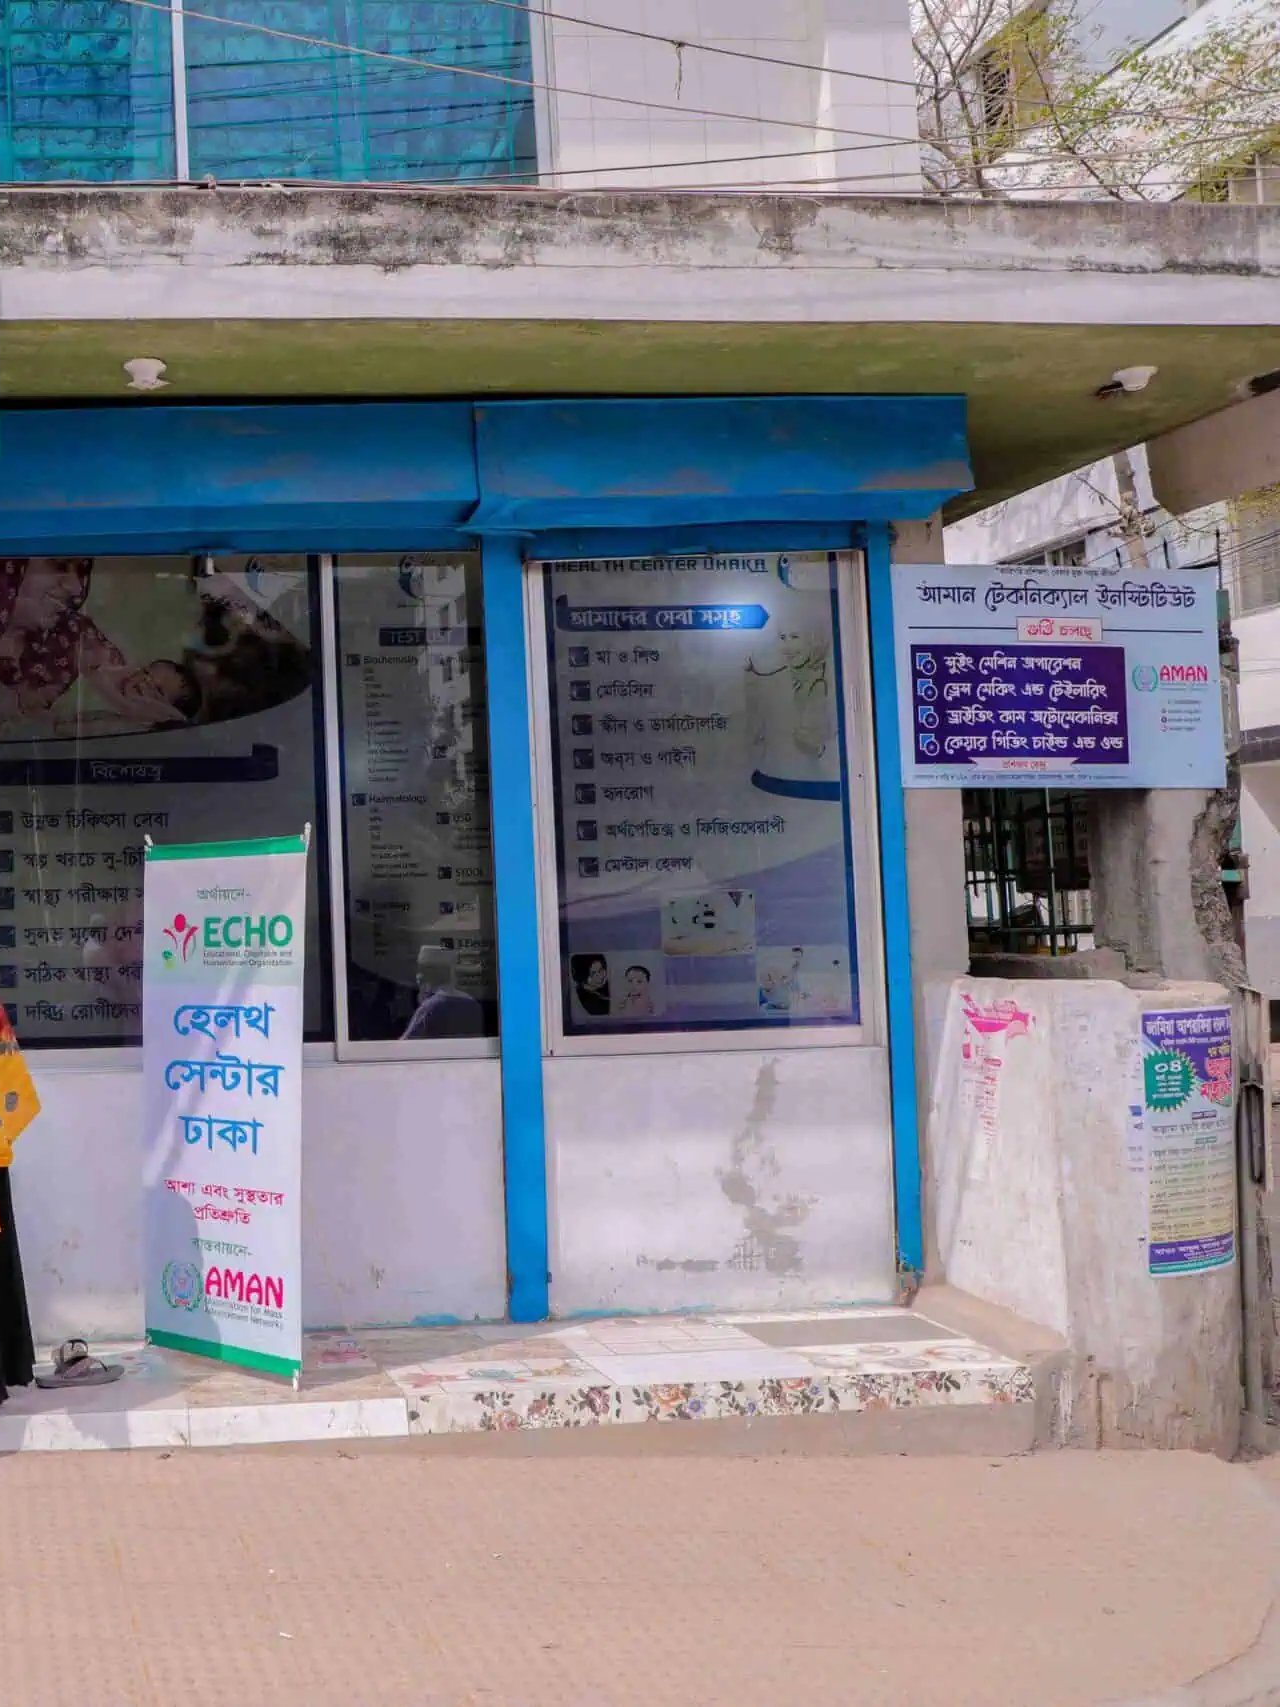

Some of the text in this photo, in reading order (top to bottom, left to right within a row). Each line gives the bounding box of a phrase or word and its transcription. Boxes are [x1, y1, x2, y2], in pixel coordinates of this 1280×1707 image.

[916, 579, 1196, 611] আমান টেকনিক্যাল ইনস্টিটিউট
[571, 609, 649, 629] আমাদের
[655, 609, 694, 629] সেবা
[595, 648, 612, 665] মা
[618, 650, 629, 664] ও
[978, 650, 1017, 674] মেশিন
[1021, 656, 1082, 676] অপারেশন
[1159, 664, 1209, 682] AMAN
[134, 811, 170, 828] সেবা
[204, 914, 293, 949] ECHO
[173, 1002, 275, 1040] হেলথ
[165, 1050, 286, 1098] সেন্টার
[178, 1114, 264, 1155] ঢাকা
[164, 1178, 195, 1196] আশা
[201, 1183, 228, 1200] এবং
[206, 1266, 284, 1310] AMAN
